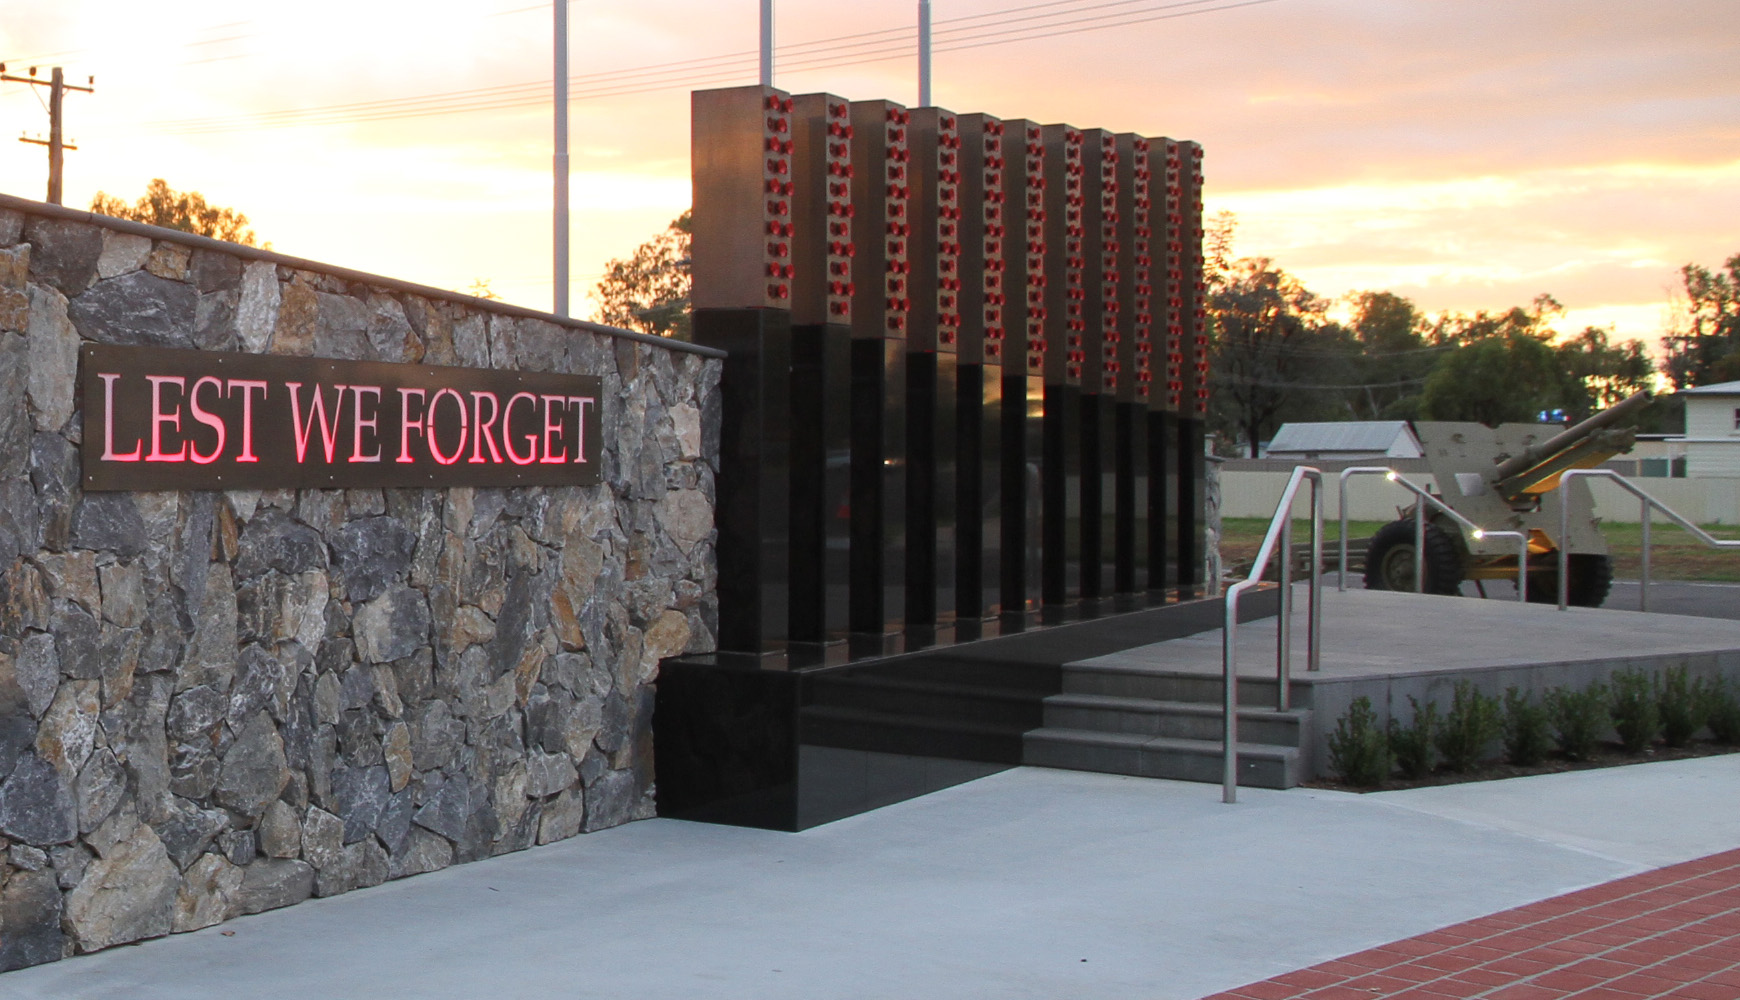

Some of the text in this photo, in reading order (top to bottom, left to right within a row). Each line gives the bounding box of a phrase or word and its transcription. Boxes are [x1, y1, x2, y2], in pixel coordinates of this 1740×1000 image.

[98, 373, 594, 464] LEST WE FORGET
